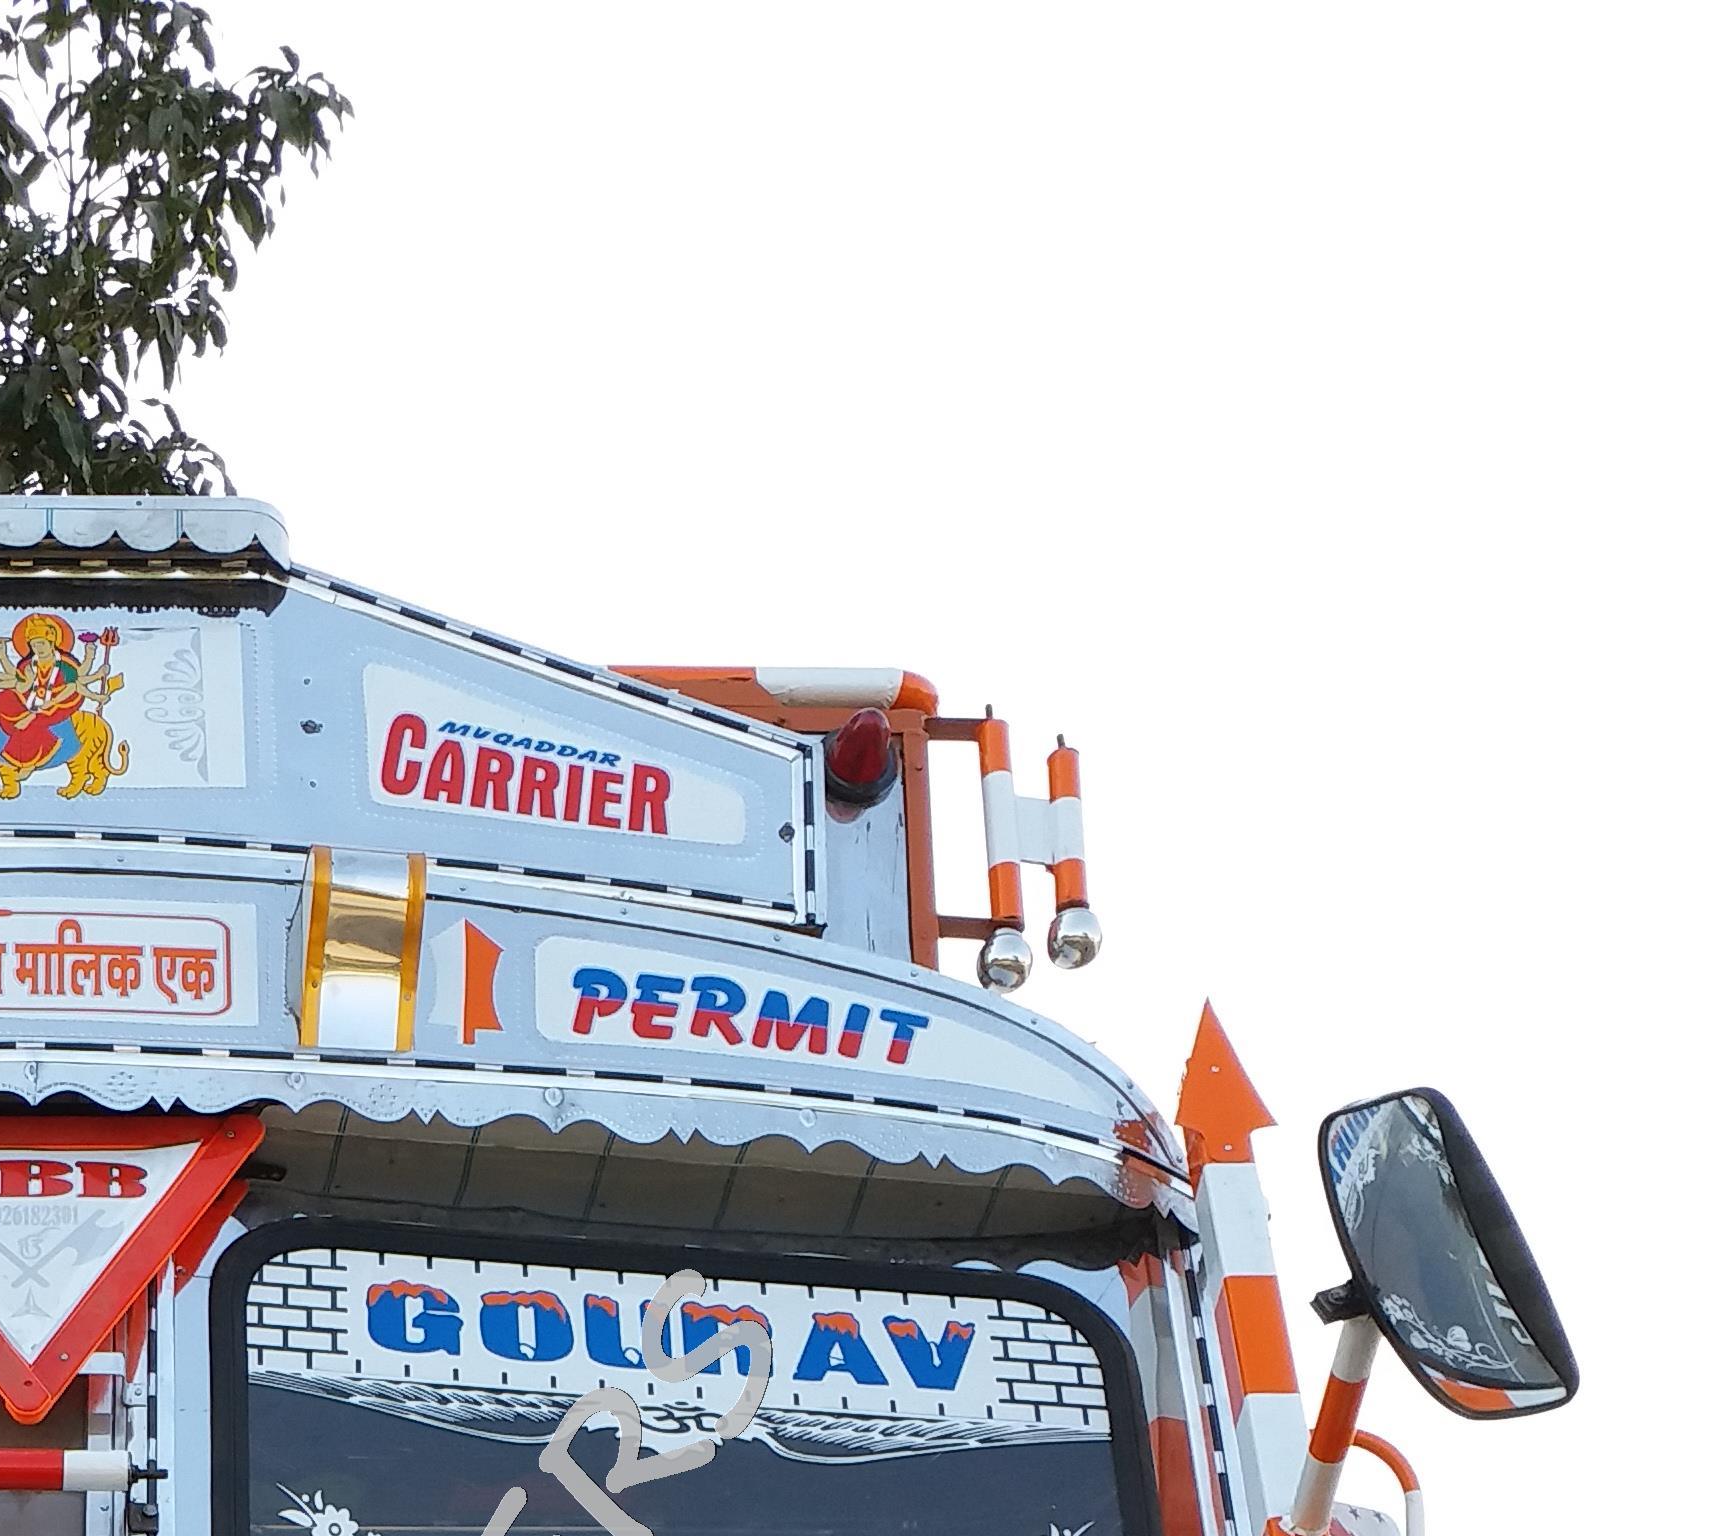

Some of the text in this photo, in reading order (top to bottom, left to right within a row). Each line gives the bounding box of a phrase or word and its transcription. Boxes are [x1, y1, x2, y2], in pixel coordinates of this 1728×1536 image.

[380, 713, 671, 835] CARRIER
[14, 919, 142, 996] मालिक
[152, 947, 217, 1003] एक
[571, 967, 929, 1066] PERMIT
[366, 1280, 975, 1391] GOURAV
